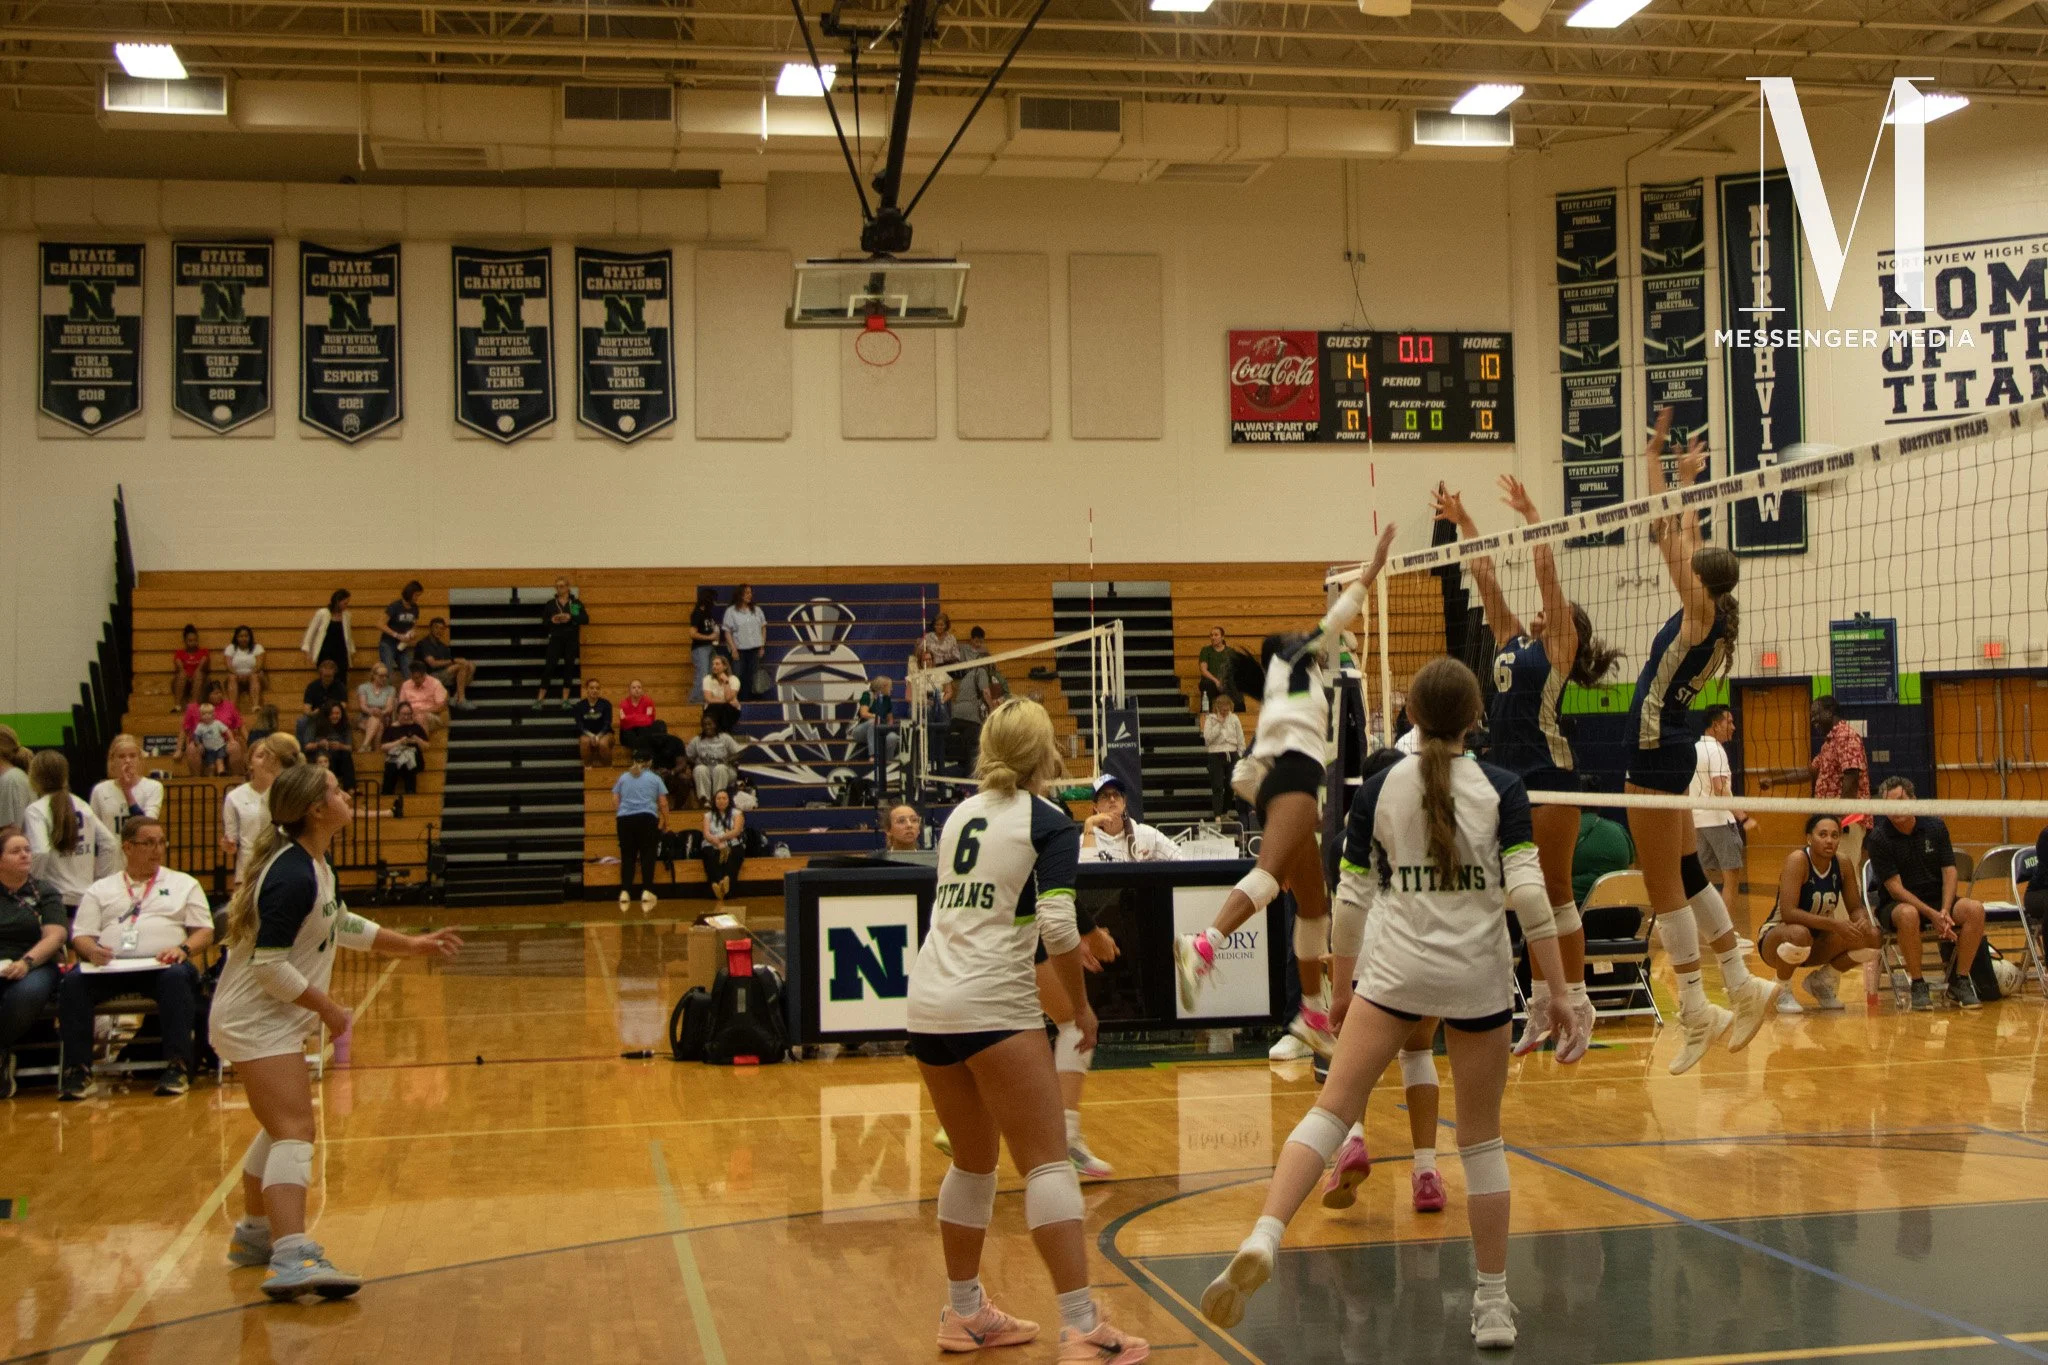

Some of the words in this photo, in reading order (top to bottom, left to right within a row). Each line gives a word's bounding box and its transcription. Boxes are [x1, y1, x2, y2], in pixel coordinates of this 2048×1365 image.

[1561, 201, 1580, 210] STATE
[1582, 198, 1611, 208] PLAYOFFS
[69, 250, 116, 262] STATE
[200, 250, 246, 263] STATE
[1664, 247, 1684, 268] N
[1984, 245, 2024, 258] HIGH
[51, 263, 135, 276] CHAMPIONS
[182, 264, 264, 277] CHAMPIONS
[328, 261, 372, 274] STATE
[481, 264, 524, 276] STATE
[603, 266, 645, 278] STATE
[311, 274, 389, 288] CHAMPIONS
[464, 276, 541, 289] CHAMPIONS
[586, 278, 662, 290] CHAMPIONS
[1648, 280, 1667, 290] STATE
[1669, 277, 1699, 288] PLAYOFFS
[1581, 286, 1614, 297] CHAMPIONS
[68, 280, 117, 322] N
[200, 280, 246, 322] N
[1655, 299, 1693, 310] BASKETBALL
[328, 291, 374, 332] N
[481, 293, 526, 334] N
[1571, 302, 1608, 313] VOLLEYBALL
[602, 293, 646, 335] N
[63, 325, 121, 335] NORTHVIEW
[195, 325, 250, 335] NORTHVIEW
[61, 335, 85, 345] HIGH
[87, 335, 124, 345] SCHOOL
[192, 335, 215, 345] HIGH
[217, 335, 254, 345] SCHOOL
[324, 335, 378, 345] NORTHVIEW
[478, 336, 529, 346] NORTHVIEW
[600, 337, 650, 347] NORTHVIEW
[1327, 336, 1370, 349] GUEST
[1463, 337, 1502, 349] HOME
[321, 345, 344, 355] HIGH
[346, 345, 381, 355] SCHOOL
[475, 347, 498, 357] HIGH
[499, 346, 533, 356] SCHOOL
[597, 347, 620, 357] HIGH
[621, 347, 653, 357] SCHOOL
[1399, 336, 1433, 363] 0.0
[1666, 336, 1686, 358] N
[1881, 326, 1952, 372] OF
[1581, 344, 1600, 365] N
[75, 356, 109, 367] GIRLS
[206, 356, 239, 367] GIRLS
[1347, 352, 1367, 379] 14
[1481, 353, 1500, 380] 10
[71, 367, 113, 379] TENNIS
[208, 367, 237, 379] GOLF
[323, 370, 379, 383] ESPORTS
[489, 367, 520, 377] GIRLS
[613, 367, 639, 377] BOYS
[1231, 355, 1318, 386] Coca-Cola
[1651, 371, 1666, 380] AREA
[1668, 367, 1703, 378] CHAMPIONS
[486, 377, 524, 388] TENNIS
[607, 378, 645, 388] TENNIS
[1382, 376, 1421, 387] PERIOD
[1566, 379, 1585, 387] STATE
[1586, 375, 1616, 385] PLAYOFFS
[1668, 381, 1685, 390] GIRLS
[1572, 387, 1610, 398] COMPETITION
[1662, 389, 1692, 399] LACROSSE
[492, 398, 519, 410] 2022
[613, 398, 640, 410] 2022
[1337, 400, 1363, 408] FOULS
[1471, 400, 1497, 408] FOULS
[1570, 396, 1613, 407] CHEERLEADING
[1481, 410, 1493, 430] 0
[2010, 409, 2021, 428] N
[1233, 422, 1275, 432] ALWAYS
[1276, 422, 1303, 432] PART
[1305, 422, 1319, 432] OF
[1244, 431, 1271, 441] YOUR
[1273, 431, 1304, 441] TEAM!
[1336, 431, 1366, 440] POINTS
[1391, 431, 1420, 440] MATCH
[1470, 431, 1499, 440] POINTS
[1669, 426, 1688, 448] N
[1899, 428, 1951, 455] NORTHVIEW
[1954, 418, 1988, 440] TITANS
[1583, 433, 1603, 454] N
[1871, 442, 1881, 461] N
[1568, 467, 1587, 476] STATE
[1589, 465, 1619, 475] PLAYOFFS
[1780, 460, 1824, 483] NORTHVIEW
[1827, 452, 1855, 471] TITANS
[1757, 472, 1765, 489] N
[1579, 482, 1608, 492] SOFTBALL
[1681, 485, 1718, 505] NORTHVIEW
[1719, 479, 1743, 496] TITANS
[1494, 652, 1516, 693] 6
[953, 817, 988, 876] 6
[938, 882, 996, 910] TITANS
[1214, 952, 1255, 960] MEDICINE
[828, 924, 908, 1001] N
